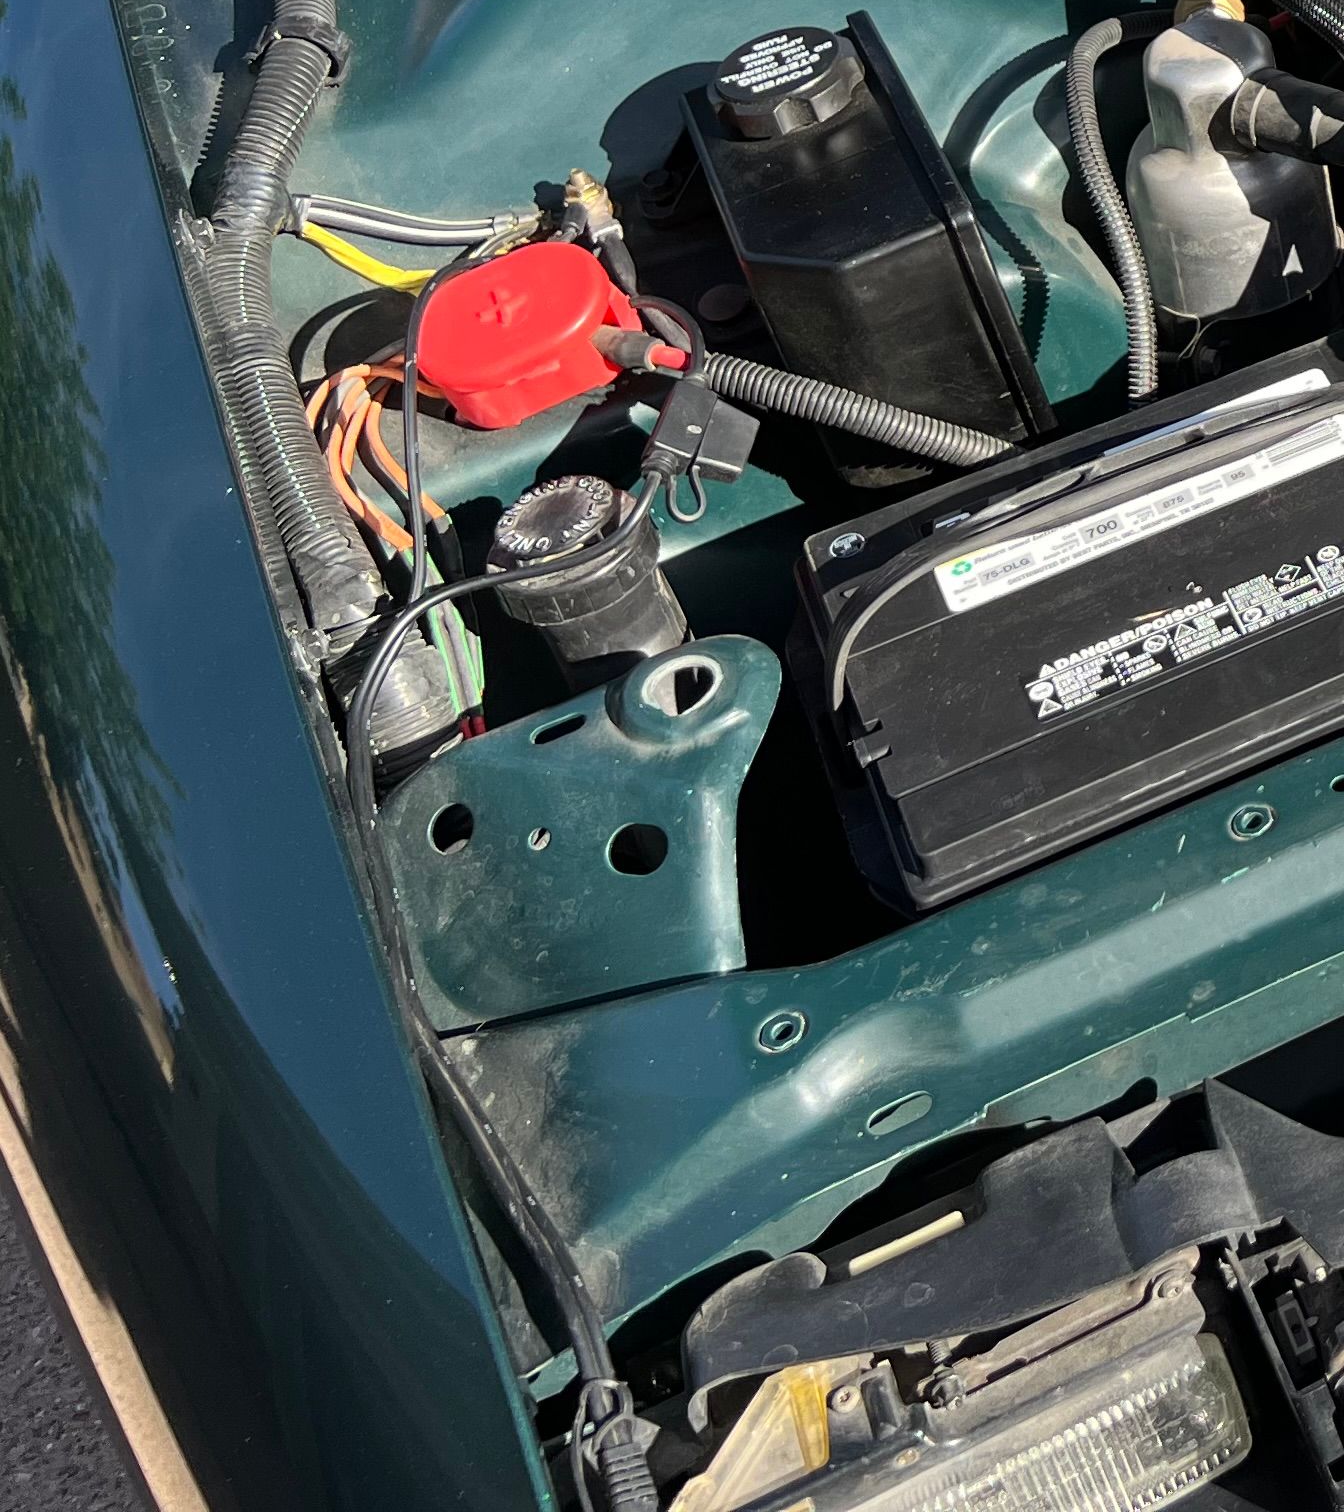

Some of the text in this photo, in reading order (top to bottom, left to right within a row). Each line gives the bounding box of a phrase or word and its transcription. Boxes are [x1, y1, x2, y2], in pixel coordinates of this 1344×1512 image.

[739, 36, 803, 63] APPROVED
[752, 34, 787, 51] FLUID
[720, 41, 832, 84] DO NOT OVERFILL
[737, 53, 820, 87] STEERING
[744, 44, 806, 70] USE ONLY
[752, 66, 813, 93] POWER
[1086, 519, 1119, 539] 700
[983, 557, 1031, 581] 75-DLG
[1053, 598, 1214, 670] DANGER/POISON
